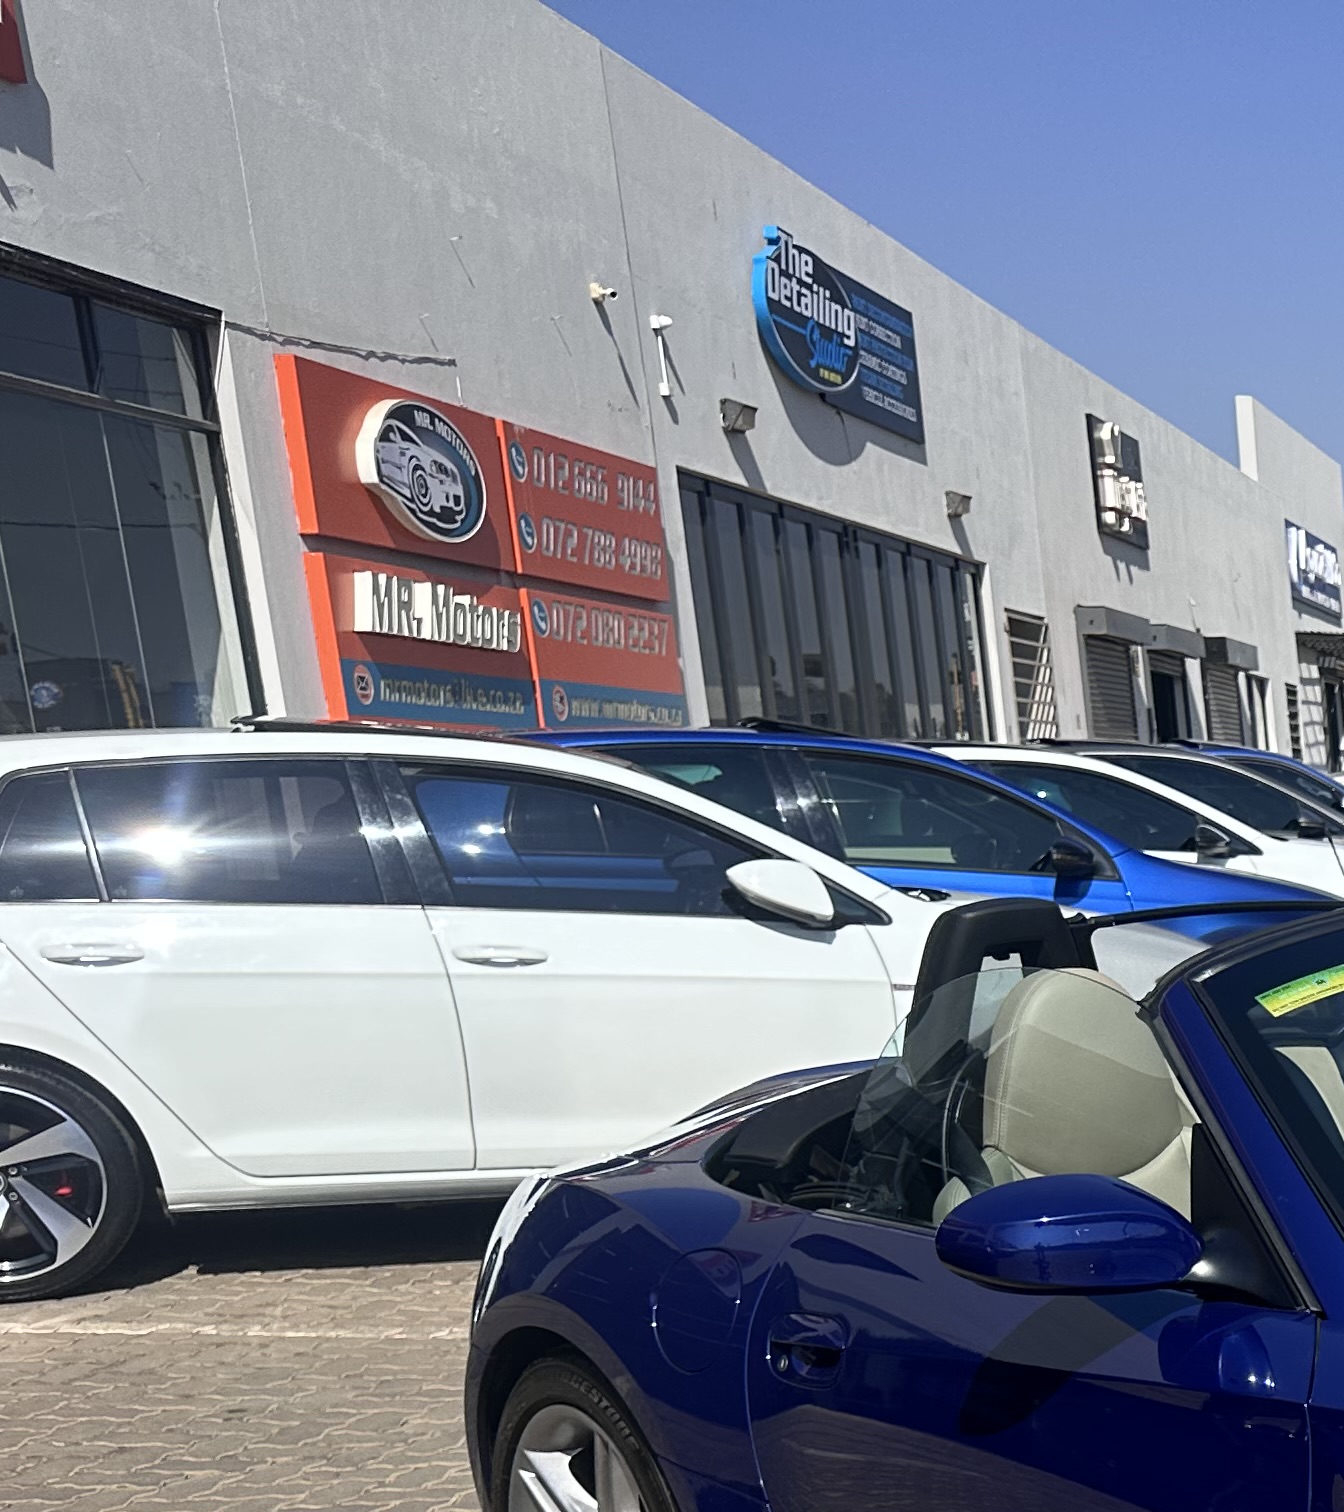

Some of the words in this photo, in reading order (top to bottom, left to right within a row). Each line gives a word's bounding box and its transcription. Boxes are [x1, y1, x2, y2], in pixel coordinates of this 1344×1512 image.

[778, 232, 815, 285] The
[767, 258, 857, 348] Detailing
[434, 417, 477, 478] MOTORS
[532, 446, 570, 496] 012
[573, 458, 609, 507] 666
[616, 471, 657, 518] 9144
[541, 516, 579, 563] 072
[582, 526, 617, 570] 788
[424, 582, 521, 653] Motors
[551, 600, 588, 645] 072
[591, 607, 626, 650] 080
[628, 613, 669, 657] 2237
